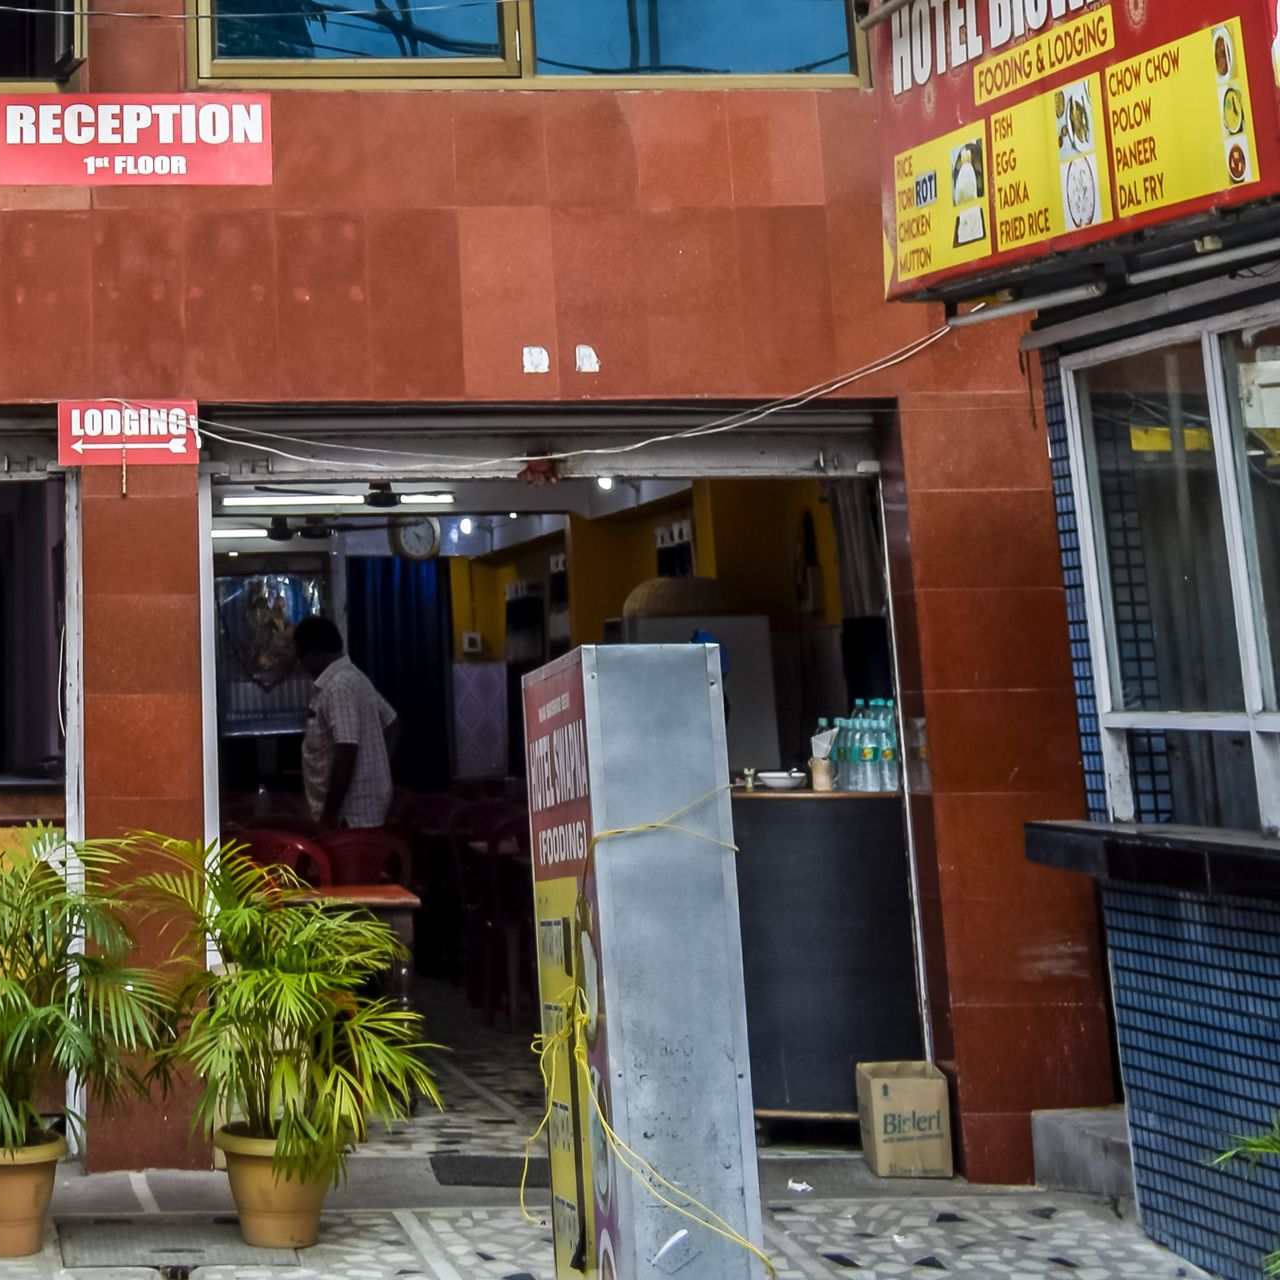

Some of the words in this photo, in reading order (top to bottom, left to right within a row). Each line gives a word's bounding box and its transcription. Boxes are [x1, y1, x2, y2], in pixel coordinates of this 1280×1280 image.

[978, 47, 1033, 99] FOODING
[1036, 48, 1045, 73] &
[1048, 16, 1108, 65] LODGING
[1108, 61, 1142, 97] CHOW
[1145, 46, 1180, 83] CHOW
[5, 103, 263, 145] RECEPTION
[994, 113, 1013, 142] FISH
[1112, 97, 1152, 135] POLOW
[83, 155, 110, 175] 1st
[115, 155, 188, 175] FLOOR
[896, 155, 913, 178] RICE
[996, 148, 1017, 176] EGG
[1115, 136, 1158, 173] PANEER
[915, 171, 937, 205] ROTI
[998, 181, 1029, 210] TADKA
[1119, 181, 1142, 210] DAL
[1143, 172, 1164, 203] FRY
[898, 212, 931, 242] CHICKEN
[999, 215, 1026, 245] FRIED
[1028, 208, 1050, 236] RICE
[899, 246, 932, 274] MUTTON
[70, 407, 188, 437] LODGING
[529, 735, 555, 812] HOTEL
[553, 718, 589, 804] SWAPNA
[538, 820, 588, 866] (FOODING)
